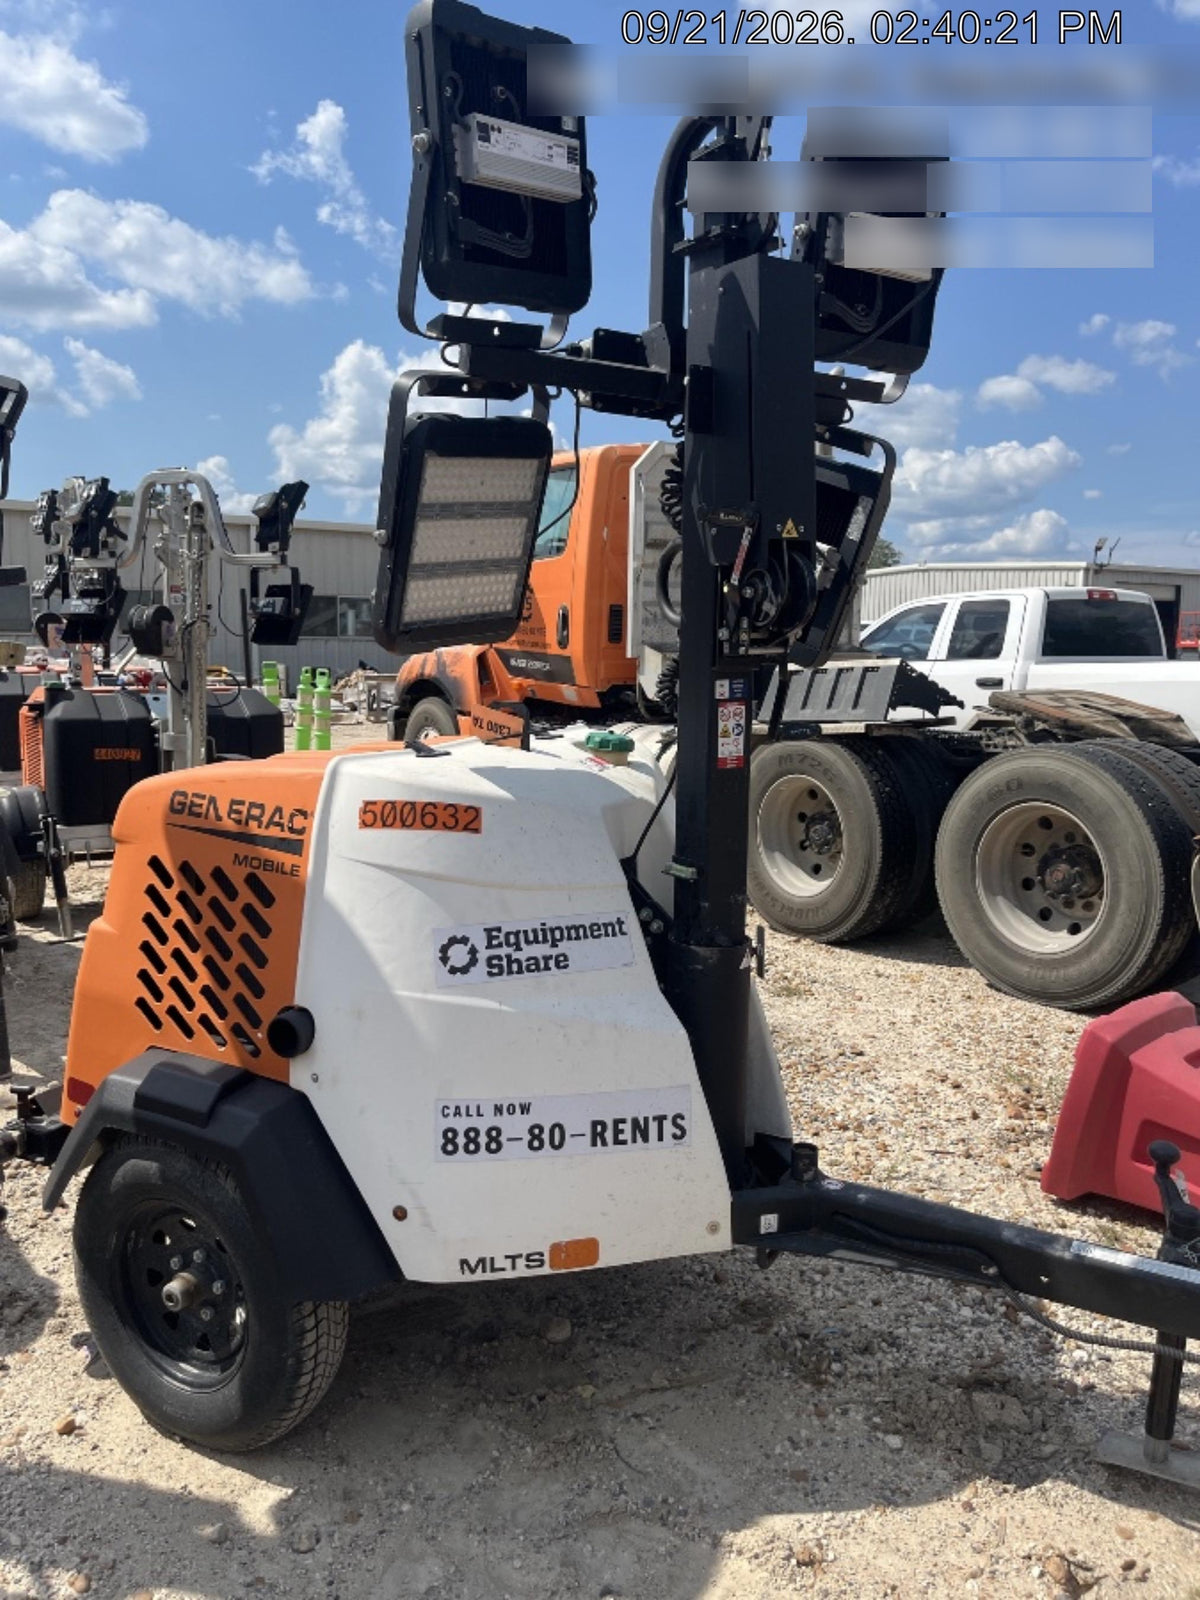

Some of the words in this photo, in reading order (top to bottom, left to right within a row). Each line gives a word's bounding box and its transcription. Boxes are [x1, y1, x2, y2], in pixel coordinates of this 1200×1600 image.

[169, 790, 308, 836] GENERAC
[362, 801, 480, 833] 500632
[232, 852, 301, 878] MOBILE
[484, 917, 628, 950] Equipment
[486, 950, 570, 978] Share
[441, 1104, 485, 1118] CALL
[493, 1102, 532, 1117] NOW
[459, 1251, 545, 1275] MLTS
